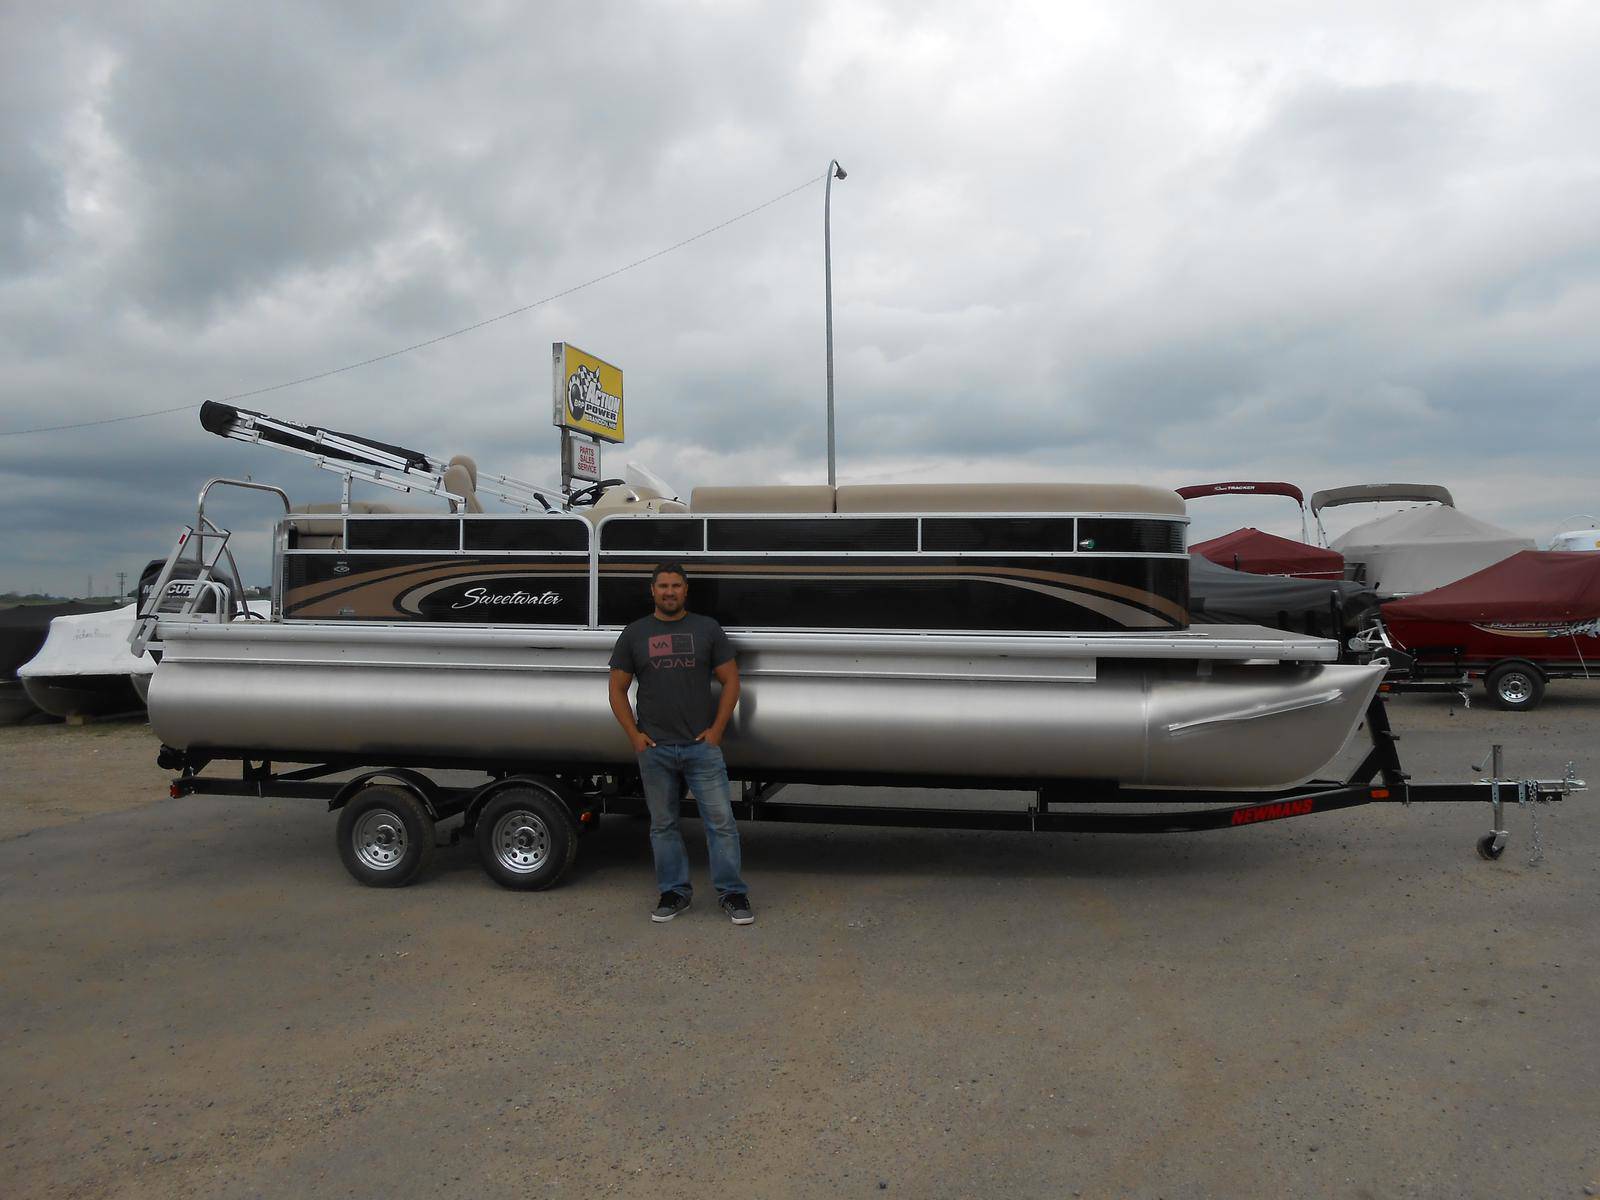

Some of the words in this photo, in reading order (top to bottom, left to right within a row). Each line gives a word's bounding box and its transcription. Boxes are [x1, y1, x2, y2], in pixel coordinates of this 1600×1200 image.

[585, 381, 620, 412] ACTION
[586, 403, 617, 420] POWER
[580, 446, 594, 456] PARTS
[580, 455, 594, 464] SALES
[577, 462, 597, 474] SERVICE
[452, 587, 564, 609] Sweetwater
[1231, 797, 1313, 825] NEWMANS
